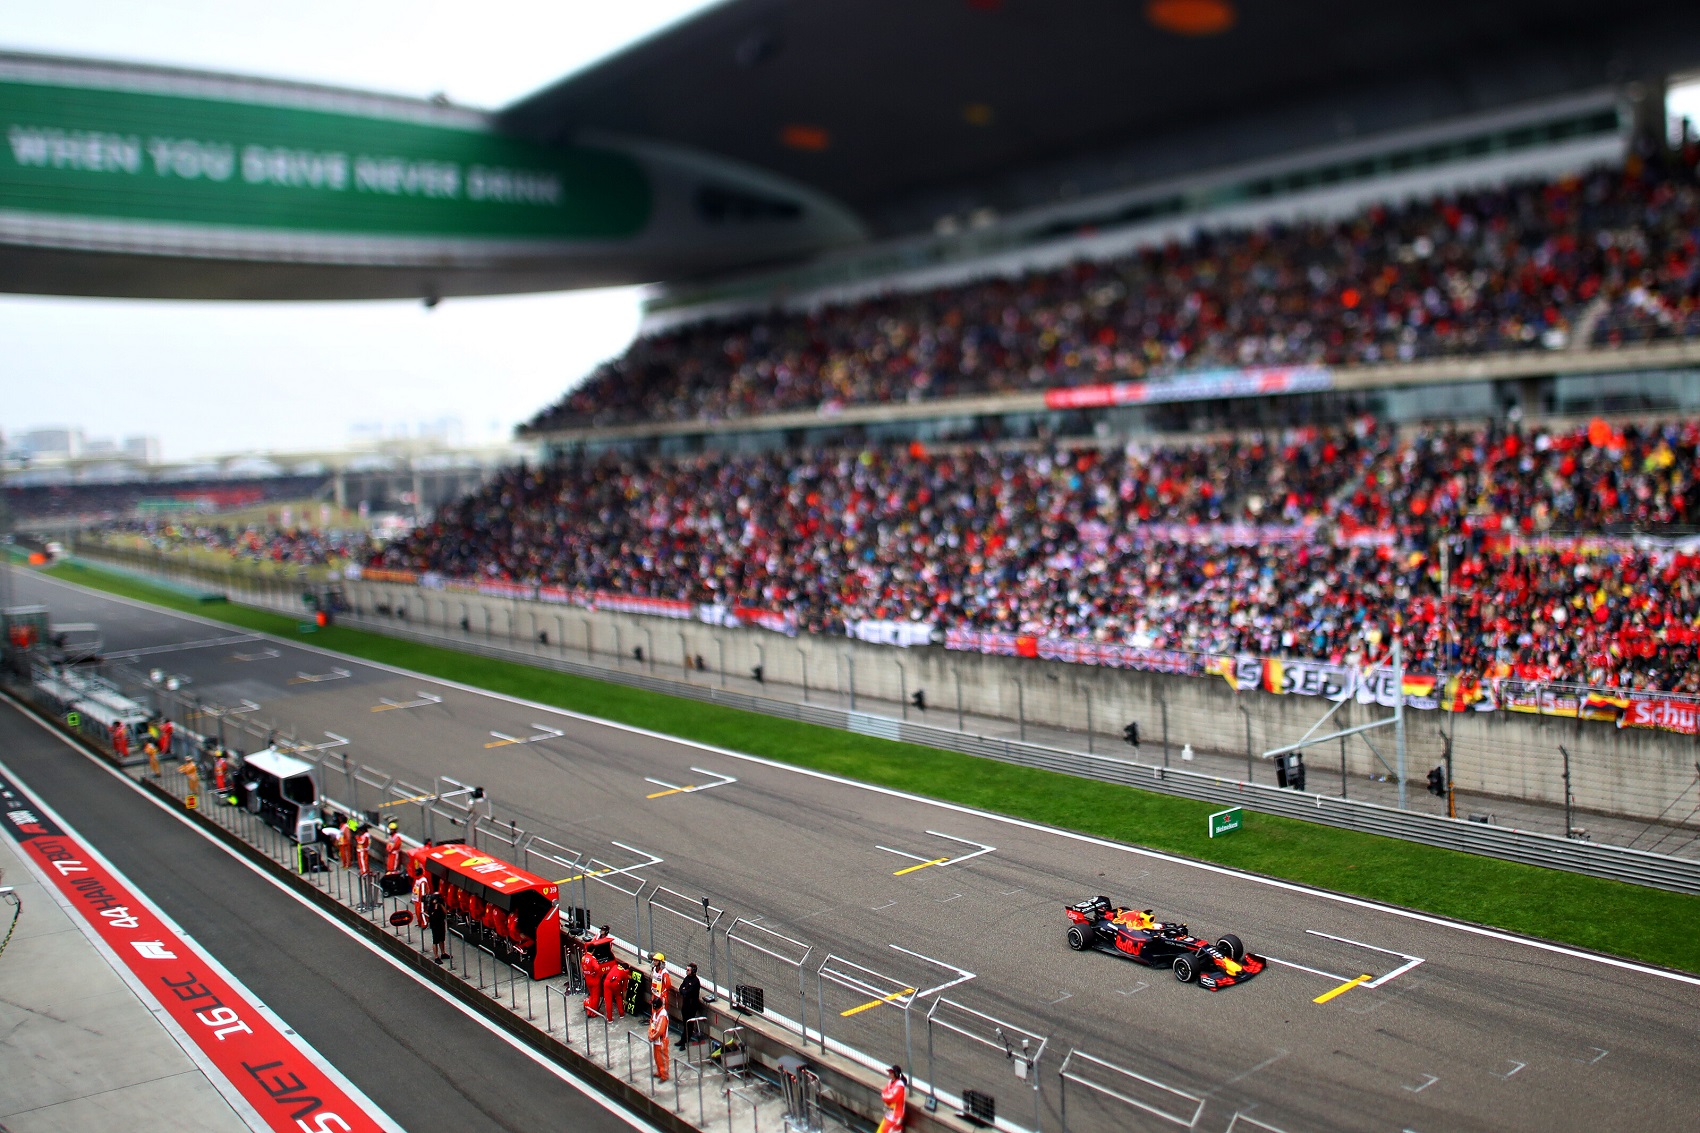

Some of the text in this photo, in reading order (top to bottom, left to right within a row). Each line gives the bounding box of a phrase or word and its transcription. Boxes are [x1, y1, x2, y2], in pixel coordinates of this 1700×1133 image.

[9, 125, 562, 207] WHEN YOU DRIVE NEVER DRINK
[1634, 700, 1700, 729] Schu
[32, 840, 88, 876] 77 BOT
[69, 876, 139, 928] 44 HAM
[161, 971, 254, 1041] 16 LEC
[240, 1060, 323, 1120] VET
